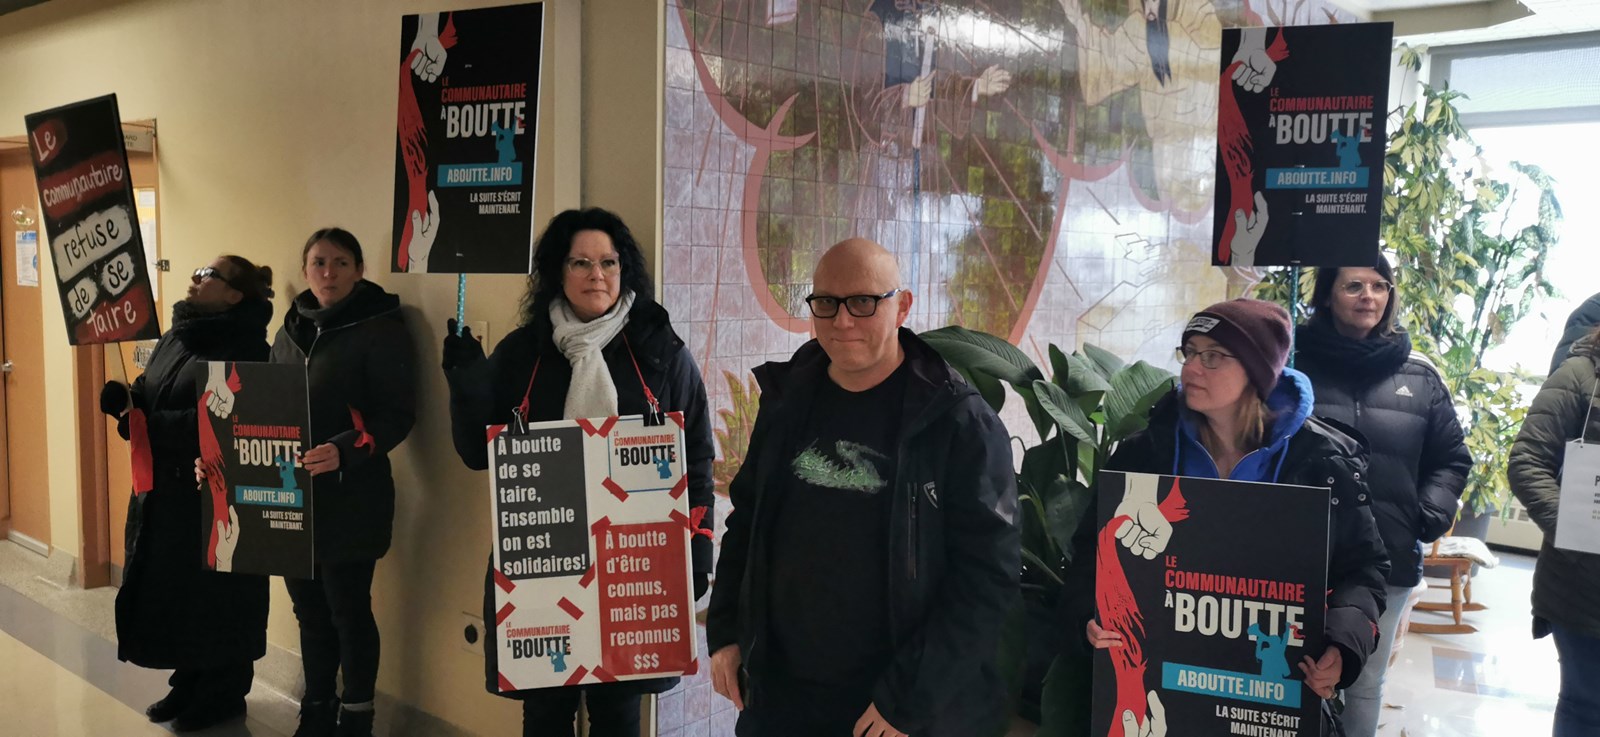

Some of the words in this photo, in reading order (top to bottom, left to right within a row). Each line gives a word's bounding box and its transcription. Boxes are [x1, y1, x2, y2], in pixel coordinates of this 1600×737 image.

[442, 77, 448, 86] LE
[441, 83, 526, 102] COMMUNAUTAIRE
[1271, 88, 1279, 96] LE
[1270, 96, 1373, 111] COMMUNAUTAIRE
[441, 105, 446, 120] À
[447, 102, 526, 138] BOUTTE
[1269, 114, 1276, 128] À
[1276, 112, 1373, 144] BOUTTE
[32, 131, 56, 162] Le
[447, 167, 512, 183] ABOUTTE.INFO
[1277, 172, 1356, 184] ABOUTTE.INFO
[470, 193, 478, 202] LA
[479, 192, 496, 202] SUITE
[1305, 194, 1315, 203] LA
[1316, 194, 1337, 203] SUITE
[1339, 192, 1367, 202] S'ÉCRIT
[479, 204, 520, 214] MAINTENANT.
[1316, 204, 1366, 214] MAINTENANT.
[64, 219, 120, 268] refuse
[74, 287, 90, 312] de
[108, 260, 129, 288] se
[86, 300, 136, 338] taire
[233, 424, 300, 438] COMMUNAUTAIRE
[614, 434, 674, 446] COMMUNAUTAIRE
[239, 439, 302, 468] BOUTTE
[498, 437, 507, 455] À
[512, 436, 561, 454] boutte
[620, 445, 676, 466] BOUTTE
[499, 464, 517, 479] de
[523, 464, 540, 478] se
[243, 489, 295, 504] ABOUTTE.INFO
[500, 485, 541, 503] taire,
[263, 510, 269, 518] LA
[270, 511, 284, 519] SUITE
[501, 507, 575, 527] Ensemble
[503, 536, 521, 551] on
[527, 532, 551, 549] est
[605, 531, 614, 550] À
[619, 529, 667, 548] boutte
[504, 554, 586, 576] solidaires!
[606, 555, 650, 574] d'être
[1166, 555, 1177, 567] LE
[607, 580, 667, 598] connus,
[1165, 569, 1304, 602] COMMUNAUTAIRE
[610, 605, 646, 622] mais
[652, 603, 678, 621] pas
[1164, 590, 1173, 608] À
[1175, 592, 1304, 647] BOUTTE
[507, 625, 570, 638] COMMUNAUTAIRE
[610, 627, 680, 646] reconnus
[513, 636, 571, 659] BOUTTE
[634, 653, 659, 670] $$$
[1178, 669, 1284, 701] ABOUTTE.INFO
[1216, 705, 1228, 718] LA
[1231, 707, 1259, 722] SUITE
[1261, 711, 1300, 728] S'ÉCRIT
